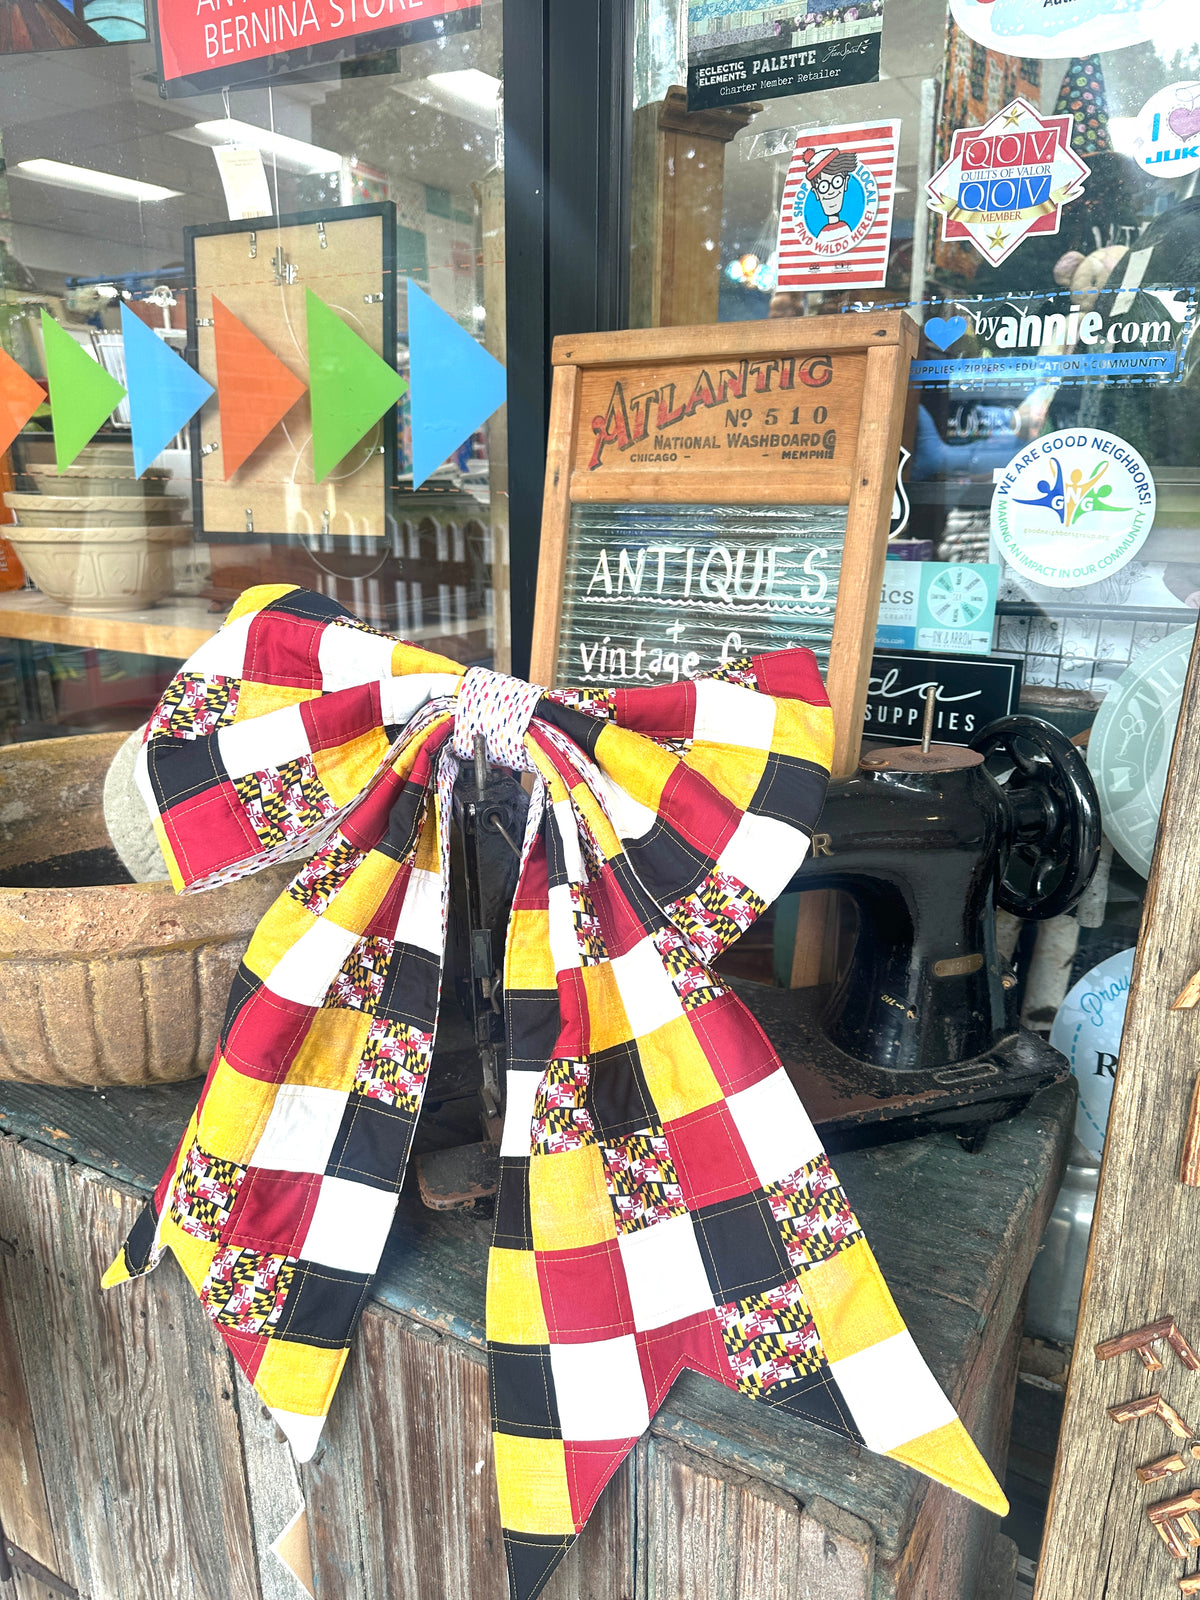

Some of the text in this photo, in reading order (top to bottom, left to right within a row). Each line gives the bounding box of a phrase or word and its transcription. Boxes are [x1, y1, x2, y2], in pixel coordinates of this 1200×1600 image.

[204, 0, 424, 58] BERNINA STO
[699, 50, 817, 77] ECLECTIC PALETTE
[699, 70, 747, 87] ELEMENTS
[720, 68, 842, 96] Charter Member Retailer
[961, 165, 1051, 182] QUILTS OF VALOR
[794, 165, 876, 217] SHOP LOCAL
[961, 177, 1049, 211] QOV
[980, 211, 1023, 222] MEMBER
[795, 210, 875, 254] FIND WALDO HERE!
[964, 362, 1005, 374] ZIPPERS
[1015, 360, 1081, 372] EDUCATION
[1091, 357, 1167, 370] COMMUNITY
[588, 355, 833, 471] ATLANTIC
[654, 435, 720, 450] NATIONAL
[727, 432, 820, 448] WASHBOARD
[630, 453, 677, 462] CHICAGO
[998, 435, 1152, 506] WE ARE GOOD NEIGHBORS!
[998, 500, 1146, 579] MAKING AN IMPACT IN OUR COMMUNITY
[586, 545, 829, 601] ANTIQUES
[579, 637, 700, 683] vintage
[864, 704, 976, 732] SUPPIES
[881, 995, 896, 1006] OIL
